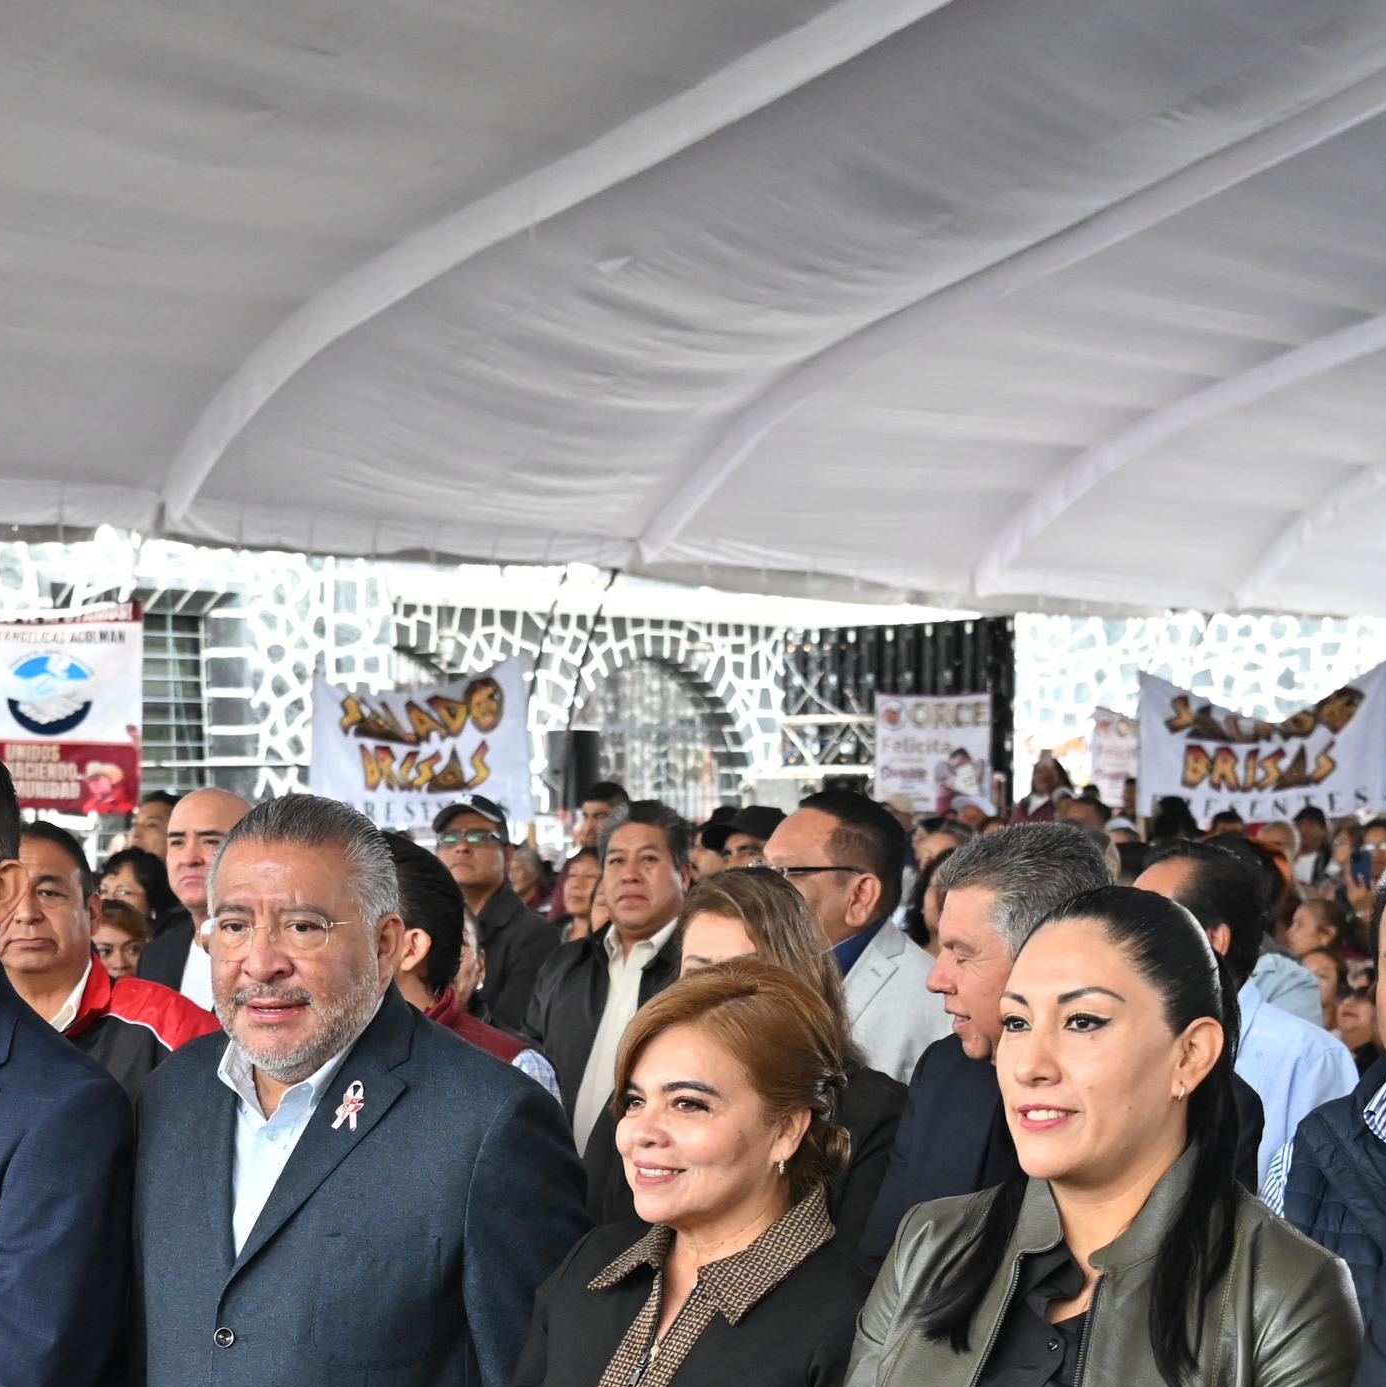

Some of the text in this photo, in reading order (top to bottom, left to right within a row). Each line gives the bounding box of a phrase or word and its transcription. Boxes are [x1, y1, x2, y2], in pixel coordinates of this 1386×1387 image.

[69, 629, 126, 645] ACOLMAN
[4, 743, 60, 761] UNIDOS
[1181, 738, 1336, 792] BRISAS
[14, 781, 81, 800] MUNIDAD
